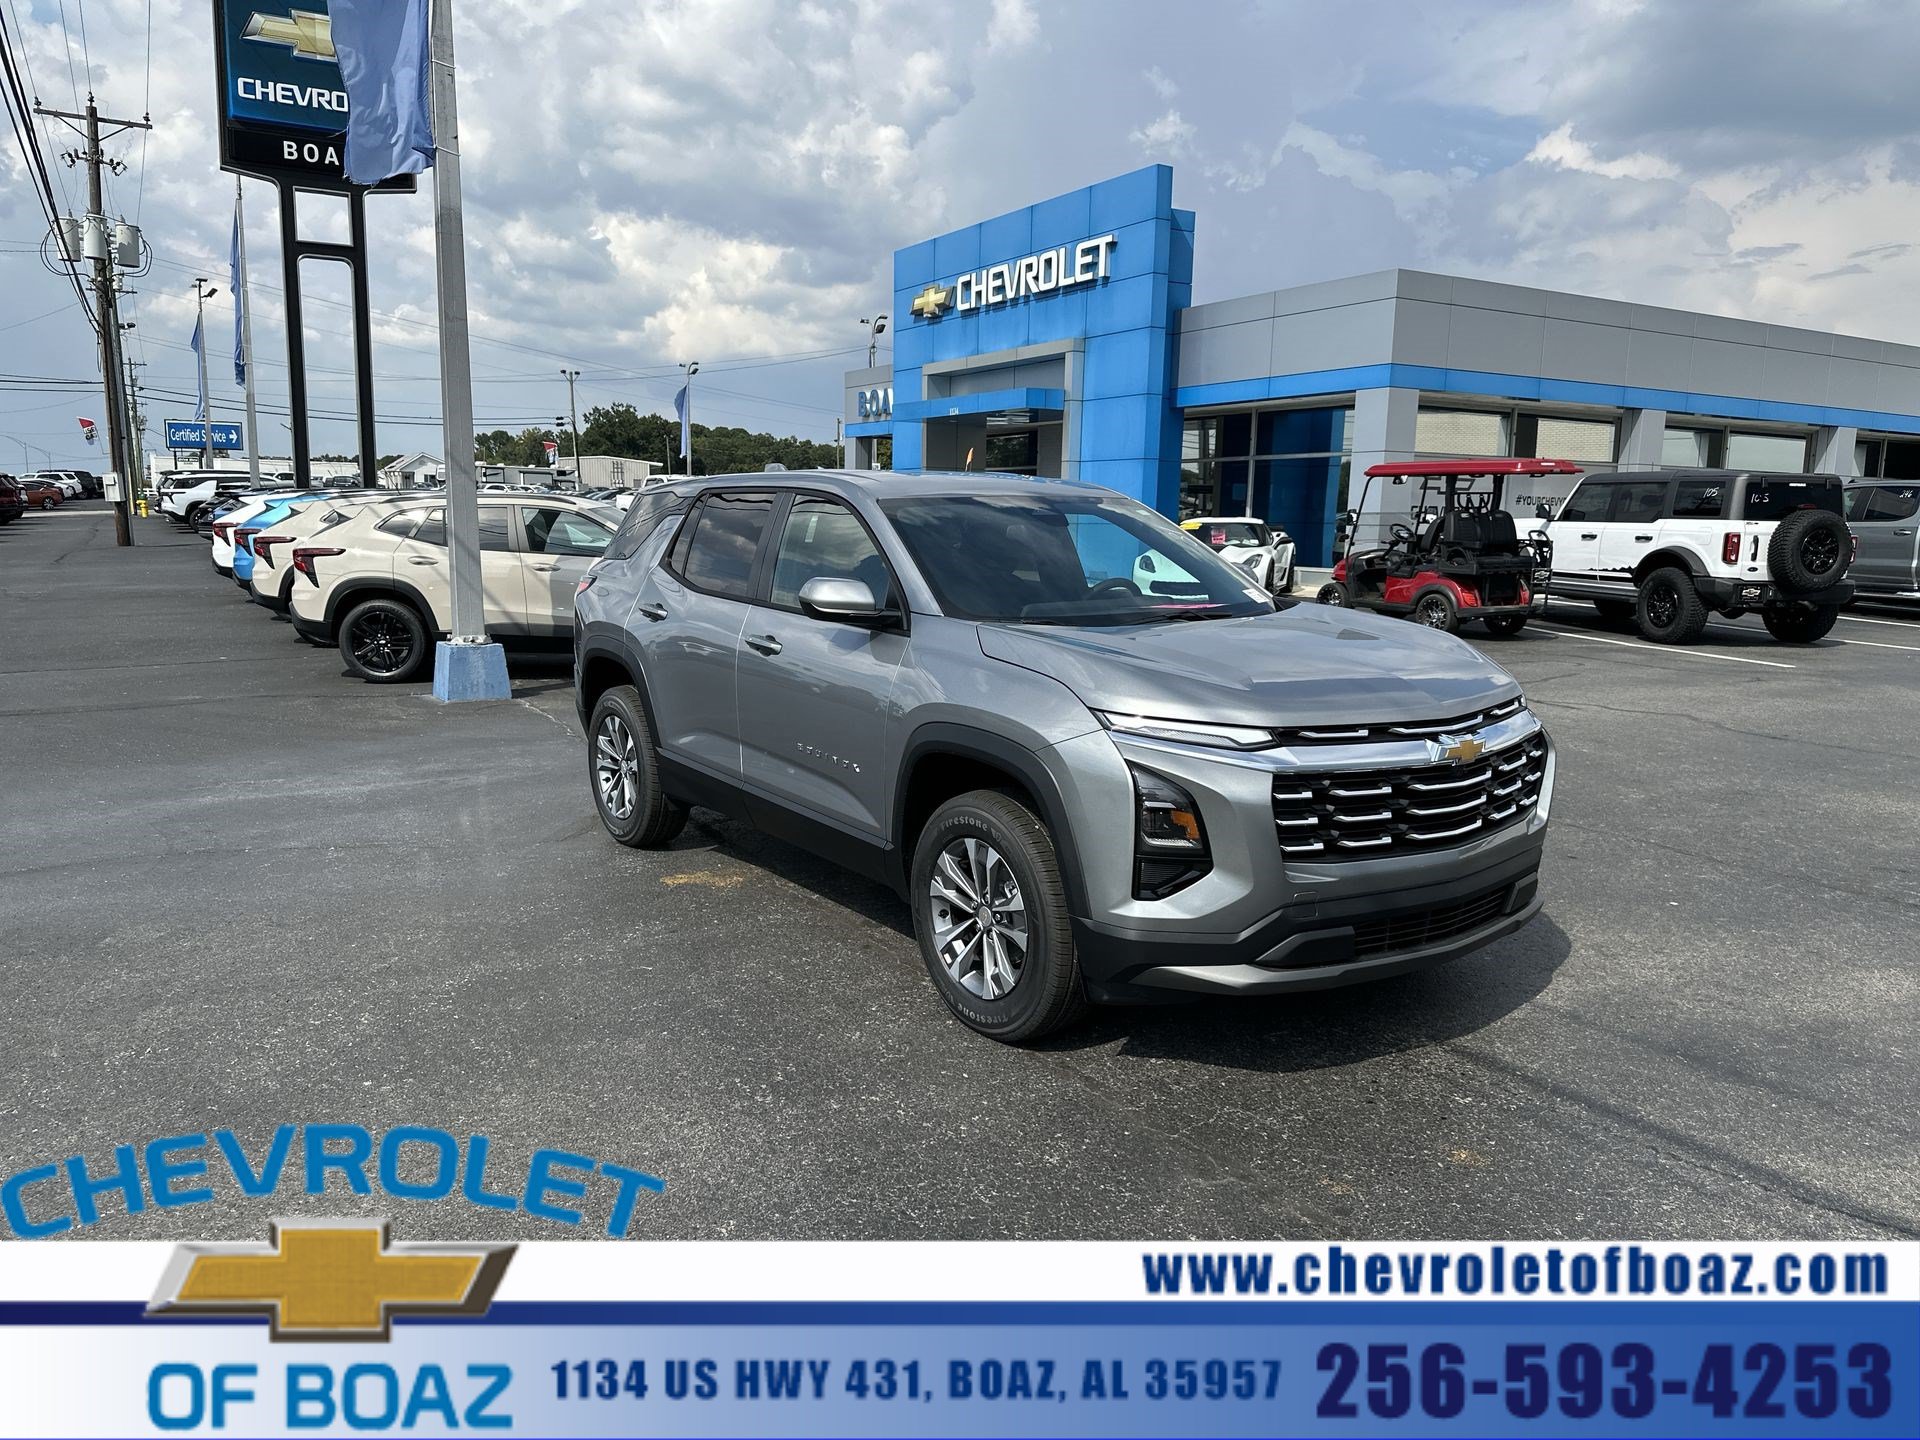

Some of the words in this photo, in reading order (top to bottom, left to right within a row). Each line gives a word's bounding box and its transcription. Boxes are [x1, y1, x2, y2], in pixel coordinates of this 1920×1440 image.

[237, 77, 349, 112] CHEVRO
[282, 140, 340, 166] BOA
[956, 234, 1114, 311] CHEVROLET
[858, 388, 891, 417] BOA
[170, 428, 200, 442] Certified
[201, 429, 227, 443] Svice
[1703, 486, 1720, 498] 105
[940, 816, 988, 831] Firestone
